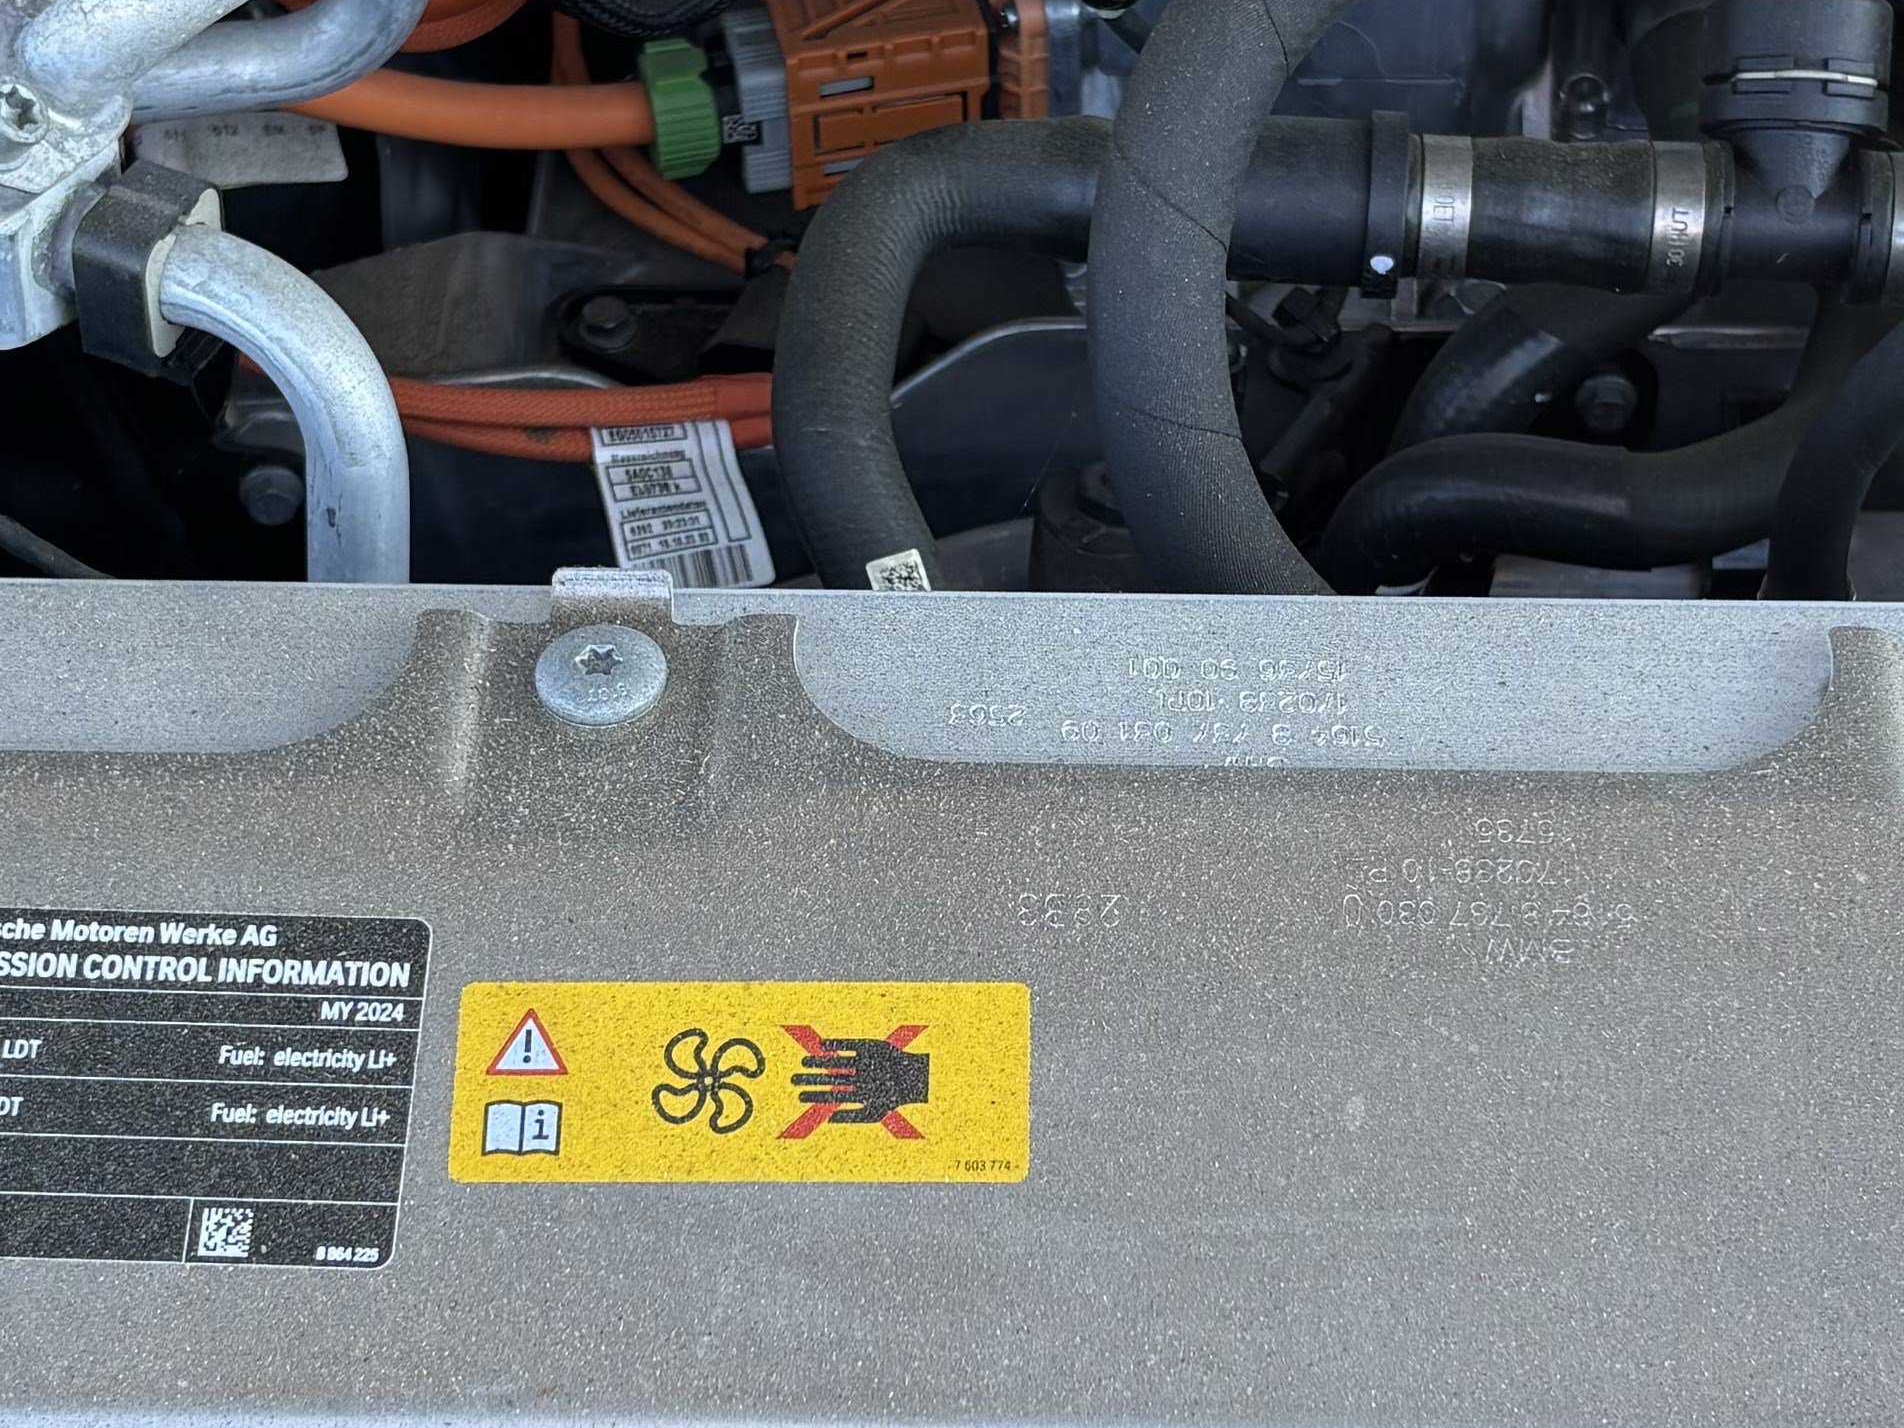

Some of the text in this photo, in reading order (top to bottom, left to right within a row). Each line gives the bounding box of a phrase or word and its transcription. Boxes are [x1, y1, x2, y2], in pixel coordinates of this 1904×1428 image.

[50, 920, 155, 944] Motoren
[161, 922, 235, 945] Werke
[242, 925, 277, 947] AG
[83, 953, 213, 983] CONTROL
[218, 958, 410, 988] INFORMATION
[321, 1001, 405, 1022] MY 2024
[3, 1039, 42, 1059] LDT
[218, 1045, 397, 1070] Fuel: electricity Li+
[211, 1103, 390, 1129] Fuel: electricity Li+
[955, 1160, 960, 1171] 7
